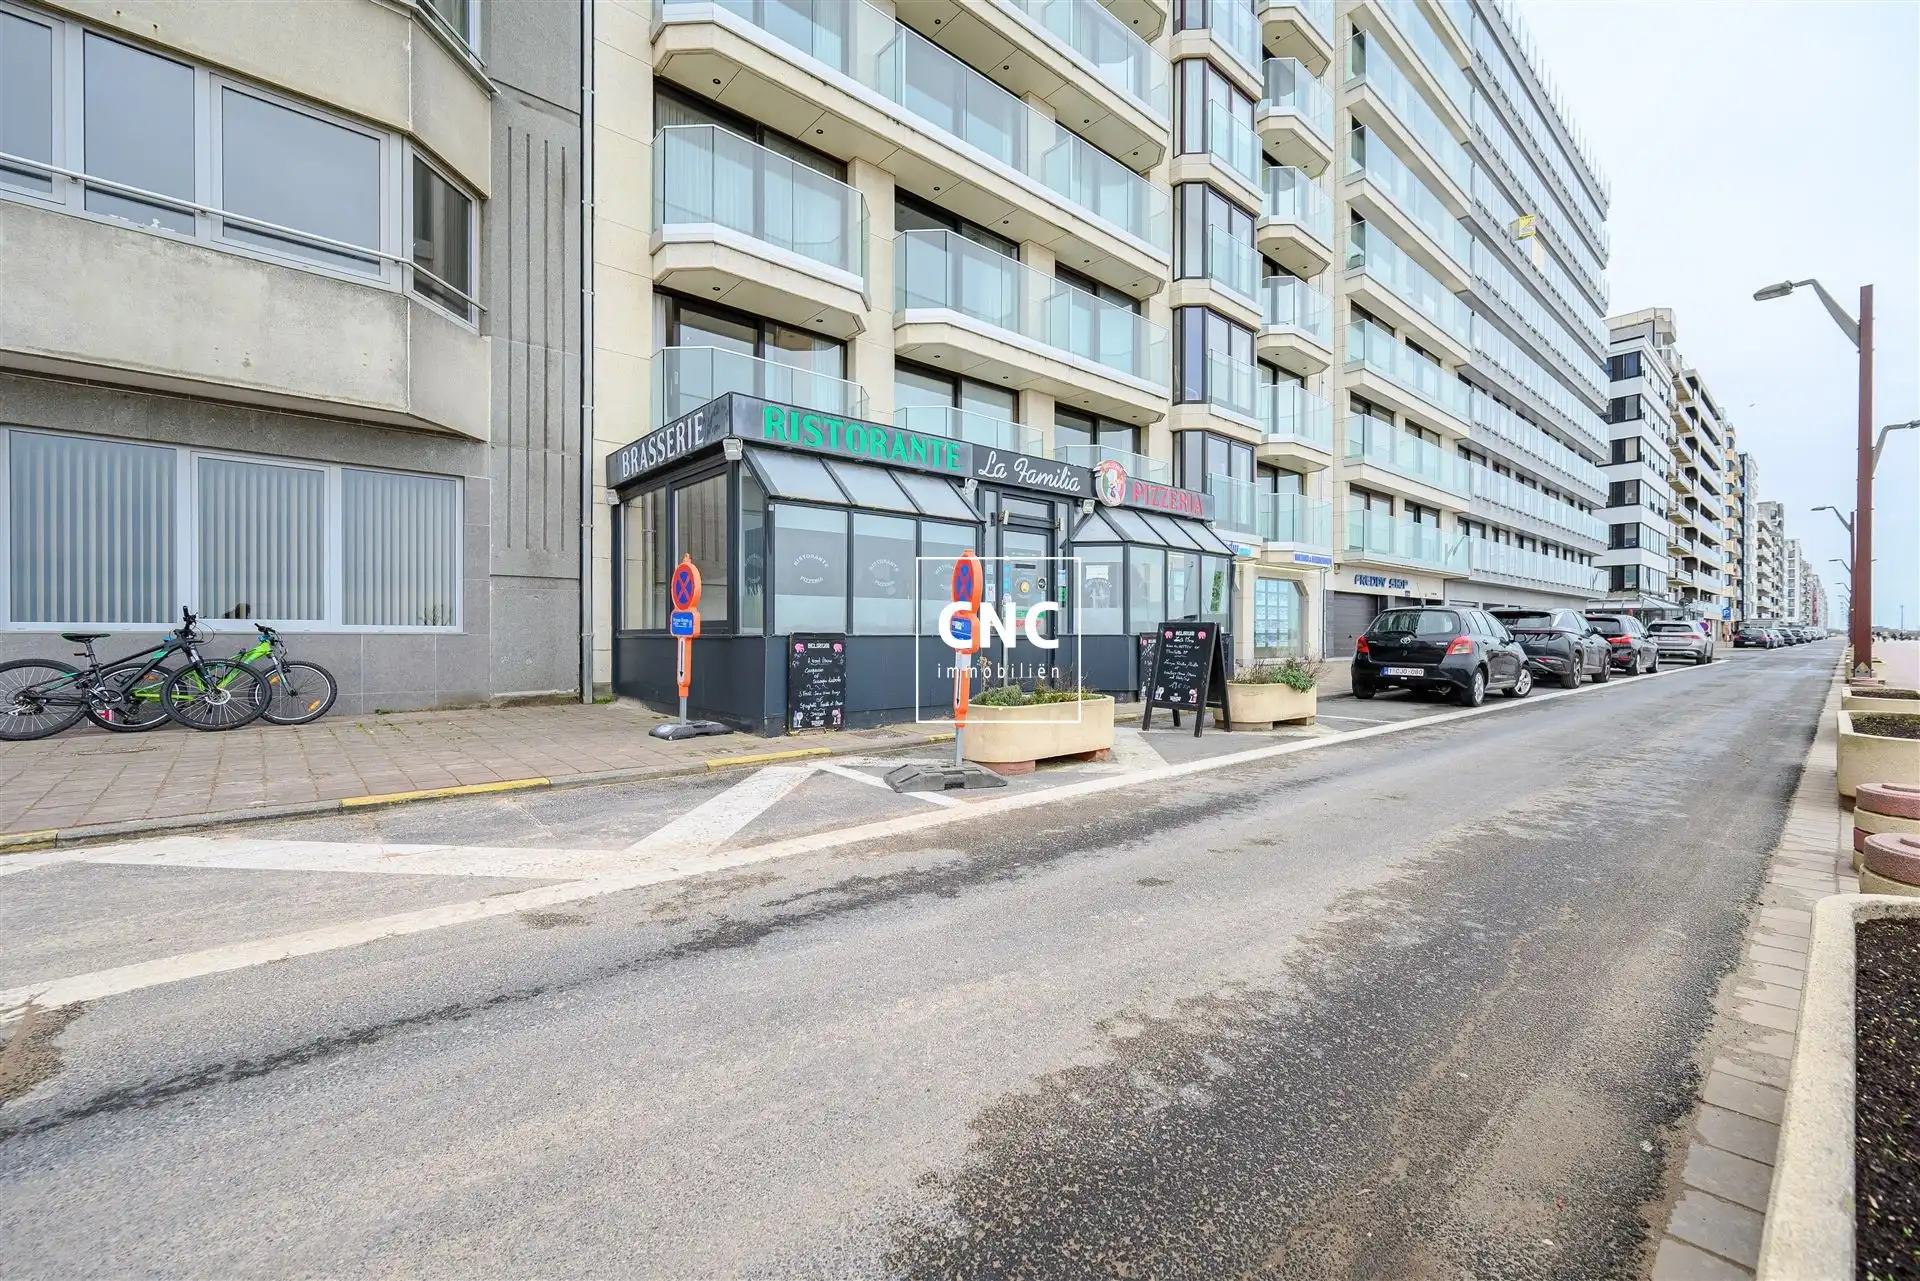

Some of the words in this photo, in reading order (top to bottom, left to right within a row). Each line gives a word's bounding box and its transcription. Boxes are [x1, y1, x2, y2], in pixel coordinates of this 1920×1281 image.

[622, 411, 705, 478] BRASSERIE
[762, 404, 962, 473] RISTORANTE
[978, 449, 1008, 479] La
[1013, 457, 1081, 493] Familia
[1132, 480, 1206, 516] PIZZERIA
